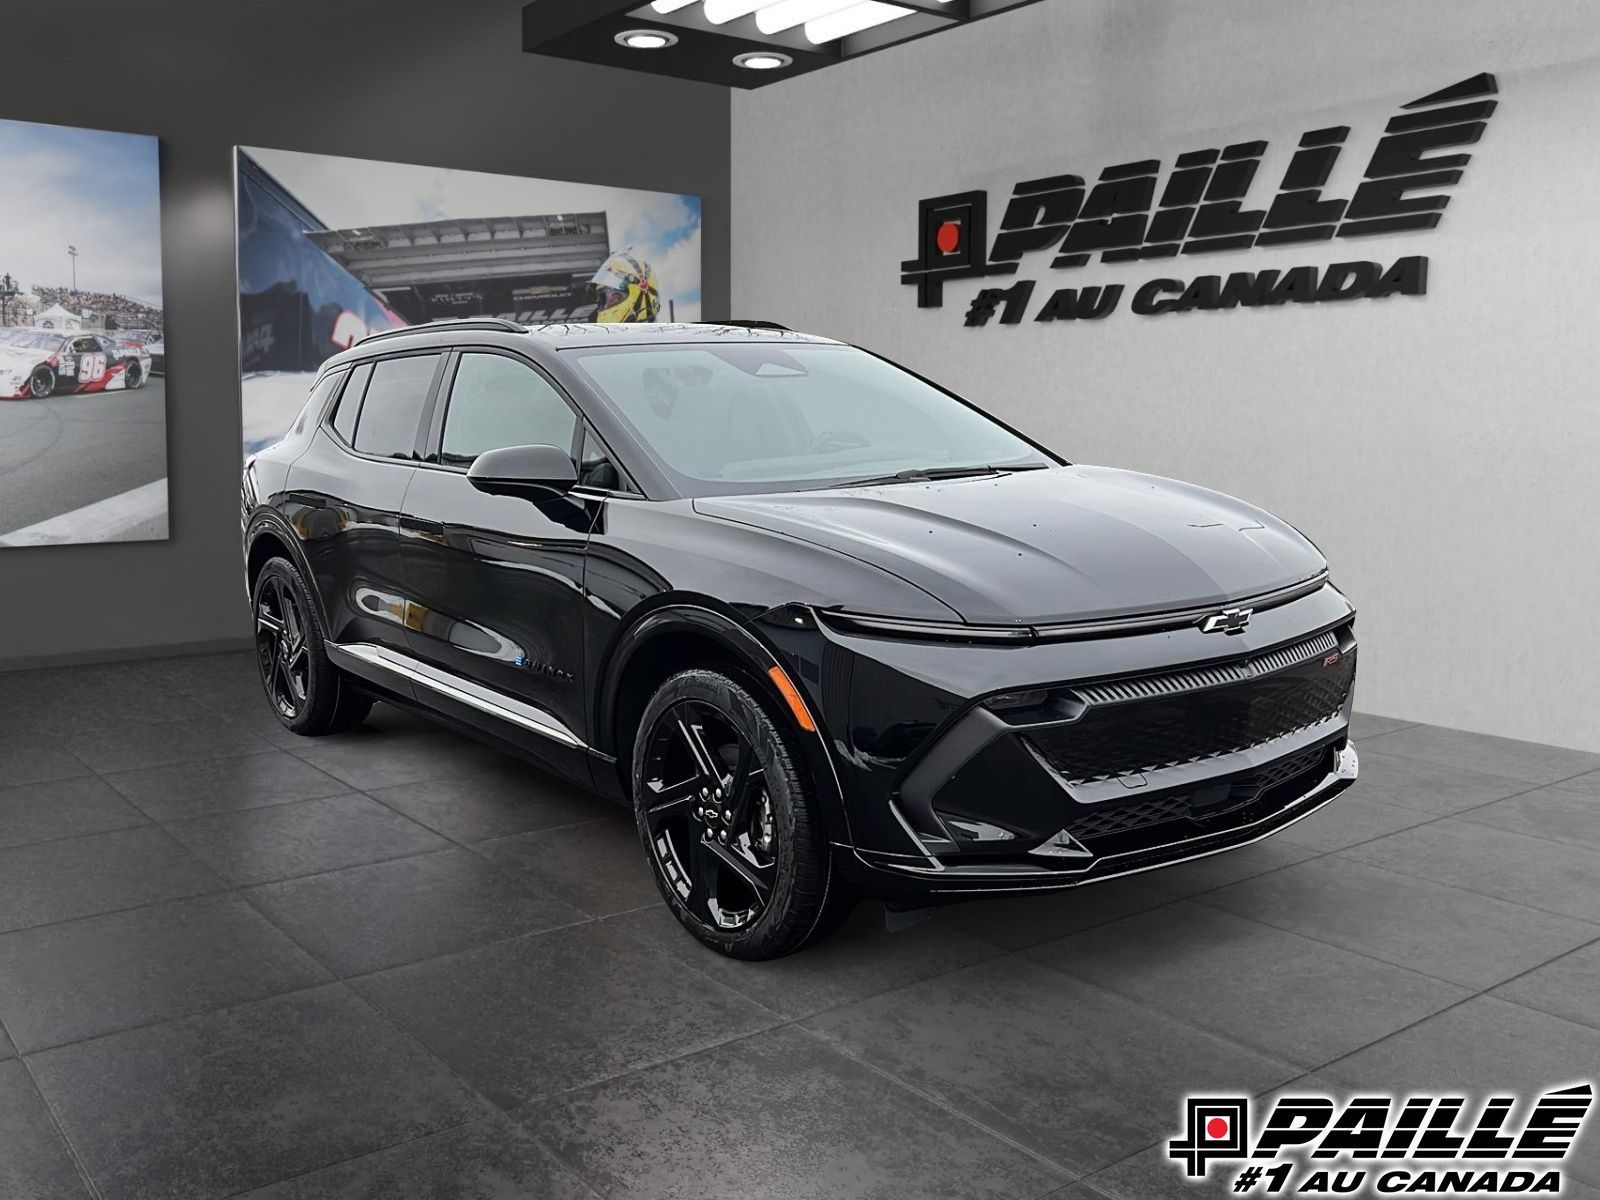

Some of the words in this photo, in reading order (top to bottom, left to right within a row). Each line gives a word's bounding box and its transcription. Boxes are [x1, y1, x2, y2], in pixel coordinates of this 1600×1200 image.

[988, 72, 1498, 268] PAILLÉ
[963, 280, 1036, 327] #1
[1034, 284, 1126, 322] AU
[1131, 255, 1429, 316] CANADA
[78, 352, 107, 384] 96
[1322, 653, 1339, 668] RS
